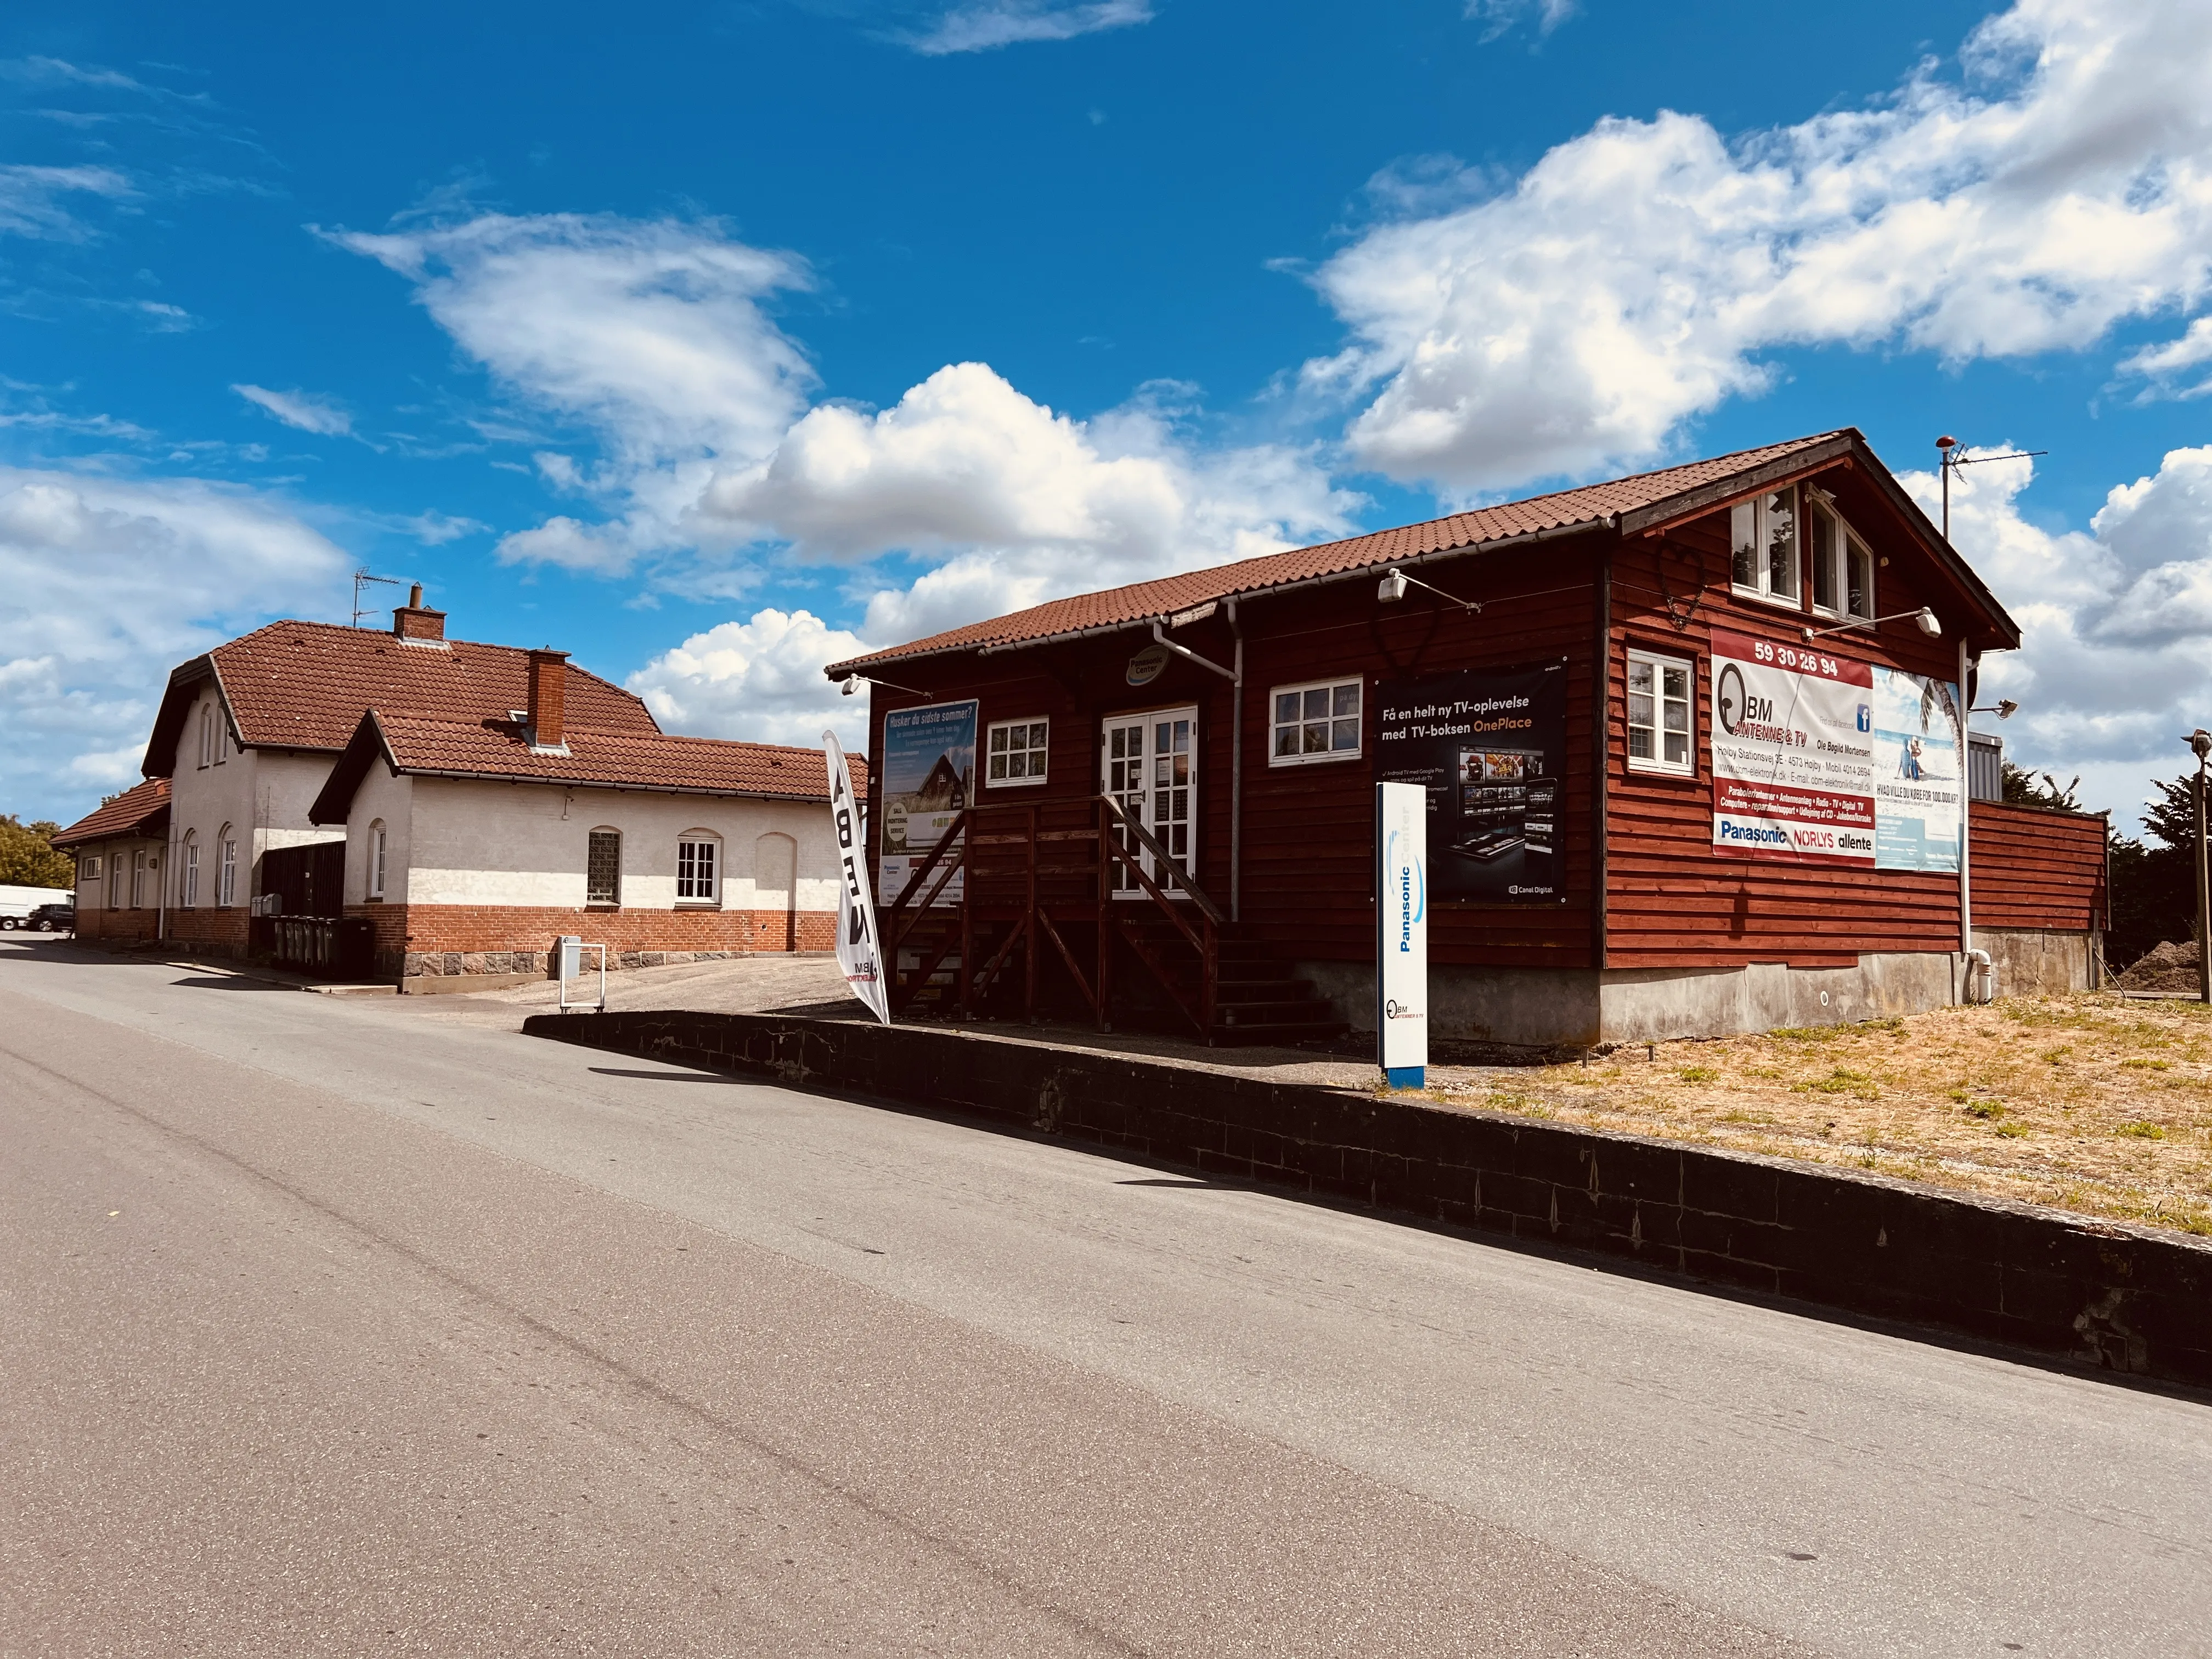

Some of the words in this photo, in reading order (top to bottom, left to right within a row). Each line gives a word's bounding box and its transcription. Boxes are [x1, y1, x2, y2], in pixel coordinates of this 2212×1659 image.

[1131, 655, 1163, 668] Panasonic
[1136, 665, 1157, 674] Center
[1755, 642, 1774, 662] 59
[1778, 648, 1796, 667] 30
[1799, 653, 1817, 672] 26
[1821, 658, 1838, 676] 94
[890, 715, 911, 728] Husker
[912, 713, 919, 725] du
[921, 711, 940, 724] sidste
[941, 706, 973, 721] sommer?
[1383, 708, 1396, 721] Få
[1398, 710, 1411, 719] en
[1414, 704, 1436, 718] helt
[1438, 706, 1452, 718] ny
[1454, 695, 1530, 715] TV-oplevelse
[1382, 727, 1406, 741] med
[1411, 723, 1470, 738] TV-boksen
[1474, 717, 1532, 732] OnePlace
[1734, 720, 1784, 743] ANTENNE
[1785, 729, 1792, 745] &
[1795, 731, 1807, 747] TV
[1818, 740, 1826, 750] Ole
[1844, 744, 1870, 758] Mortensen
[1738, 748, 1774, 765] Stationsvej
[1788, 756, 1803, 768] 4573
[1826, 761, 1842, 773] Mobil
[1843, 765, 1856, 775] 4014
[1857, 767, 1870, 777] 2694
[1816, 797, 1829, 807] Radio
[1832, 799, 1839, 808] TV
[1857, 802, 1864, 811] TV
[1877, 784, 1889, 796] HVAD
[1891, 786, 1903, 797] VILLE
[1903, 787, 1910, 798] DU
[1923, 790, 1932, 801] FOR
[1826, 809, 1833, 819] CD
[1401, 806, 1410, 864] Center
[1721, 820, 1787, 844] Panasonic
[1794, 830, 1834, 848] NORLYS
[1838, 833, 1871, 850] allente
[1401, 866, 1410, 952] Panasonic
